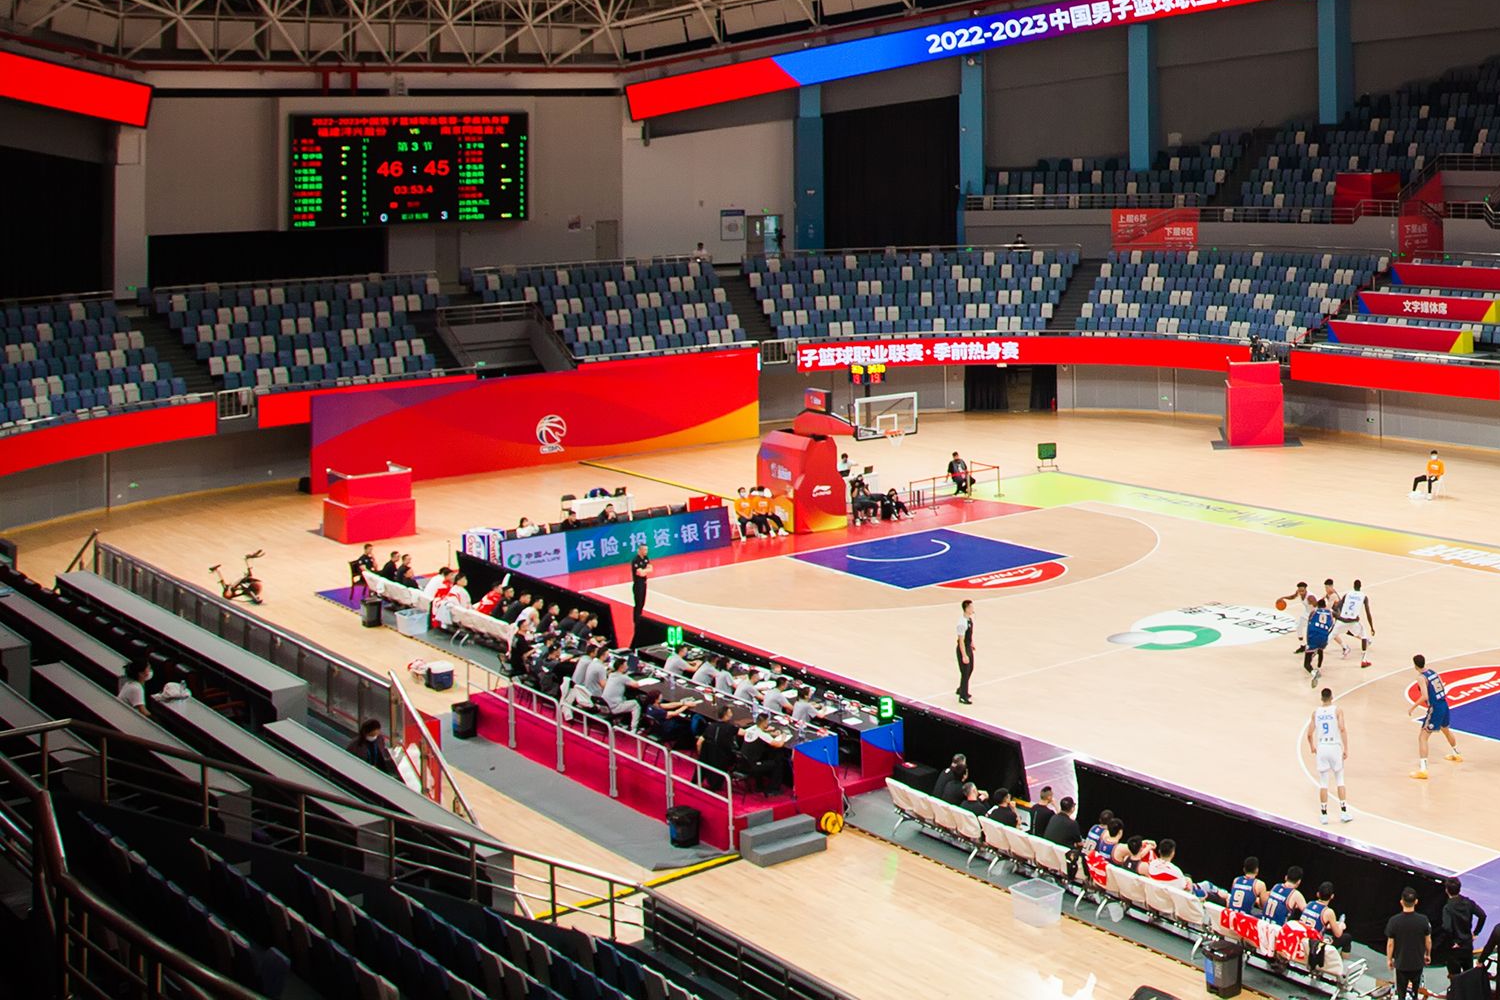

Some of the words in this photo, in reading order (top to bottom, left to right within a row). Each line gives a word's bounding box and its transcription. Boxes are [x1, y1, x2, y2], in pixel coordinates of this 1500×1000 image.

[377, 161, 403, 177] 46
[424, 160, 450, 176] 45
[441, 211, 448, 220] 3
[1403, 300, 1448, 315] 文字媒体席
[525, 549, 560, 559] 中国人寿
[880, 697, 893, 718] 3
[1322, 722, 1329, 734] 9
[1232, 889, 1245, 908] 9
